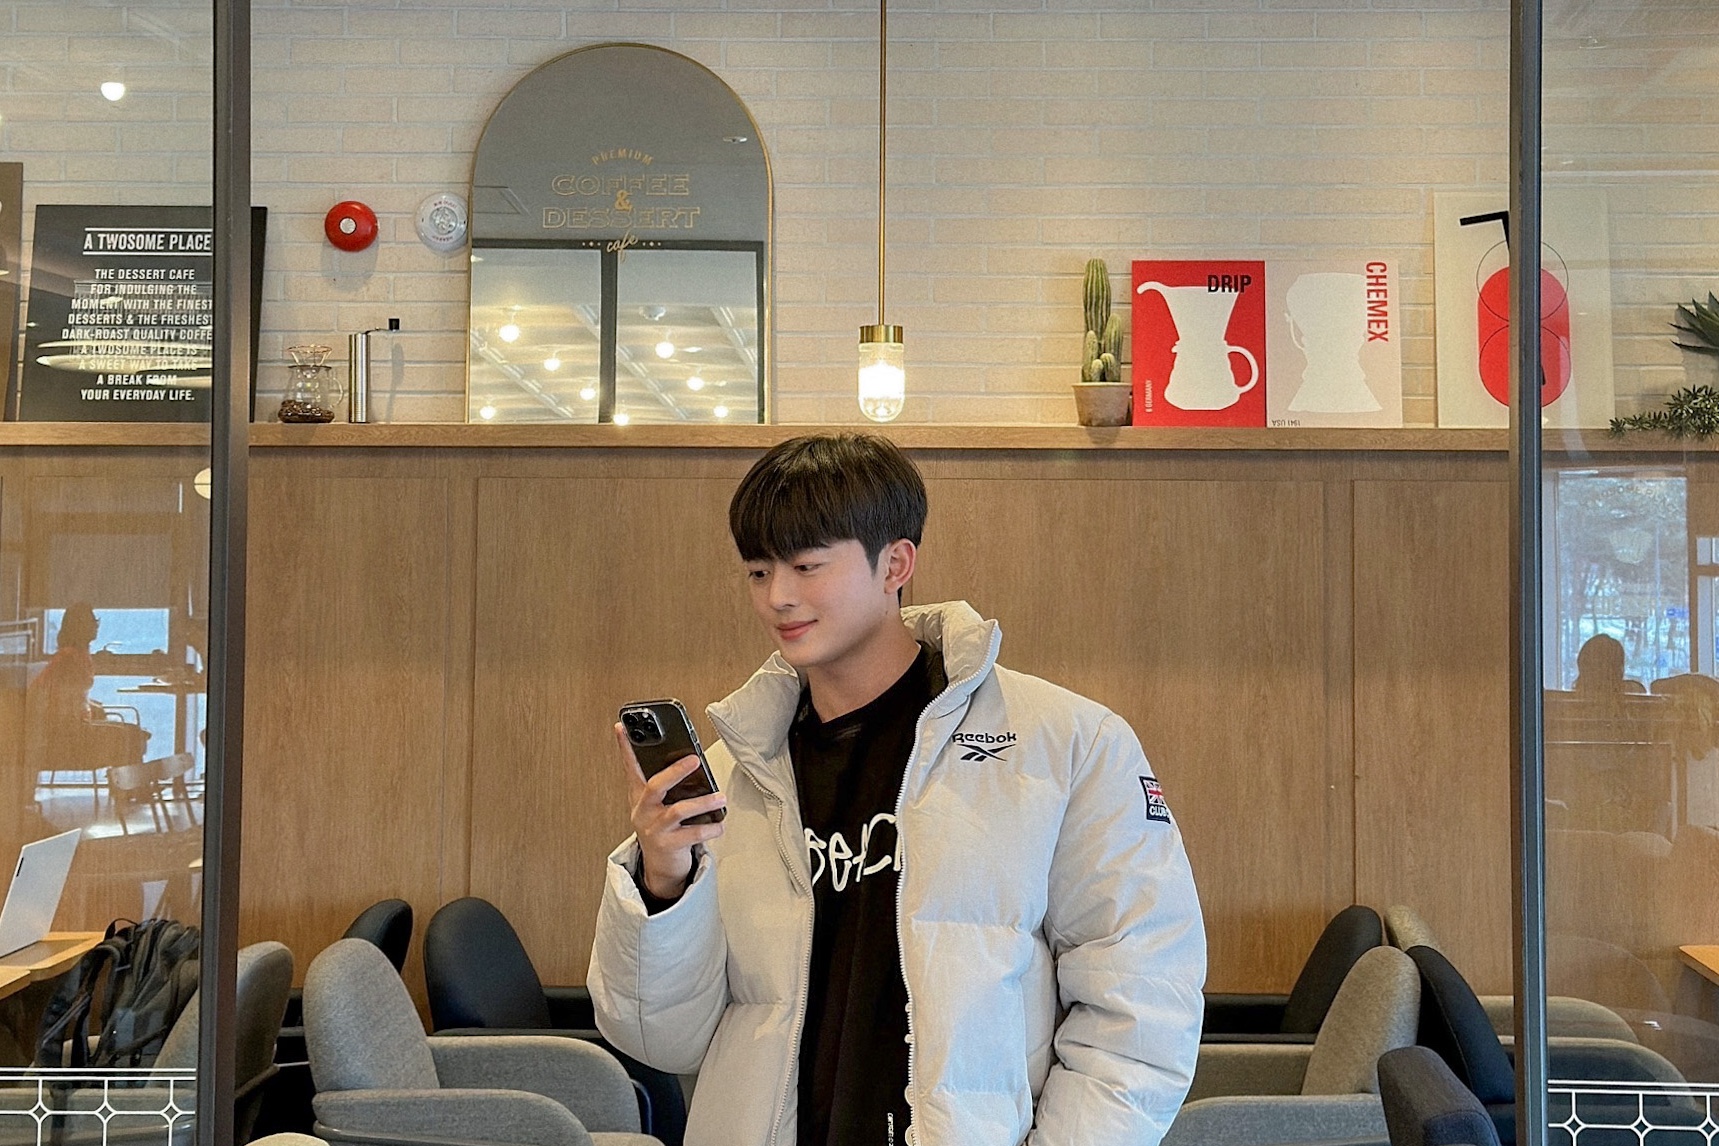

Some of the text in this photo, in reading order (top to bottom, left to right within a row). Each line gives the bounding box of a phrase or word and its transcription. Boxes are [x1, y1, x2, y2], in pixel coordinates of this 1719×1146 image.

[551, 173, 690, 196] COFFEE
[614, 189, 633, 211] &
[542, 206, 701, 229] DESSERT
[83, 233, 212, 250] A TWOSOME PLACE
[606, 230, 639, 263] cafe
[94, 268, 195, 280] THE DESSERT CAFE
[90, 283, 197, 295] FOR INDULGING THE
[1207, 274, 1252, 294] DRIP
[71, 298, 212, 310] MOMENT WITH THE FINEST
[1365, 261, 1389, 343] CHEMEX
[67, 313, 123, 325] DESSERTS
[126, 314, 134, 325] &
[138, 314, 158, 325] THE
[61, 328, 212, 341] DARK-ROAST QUALITY COFFE
[80, 344, 198, 355] A TWOSOME PLACE IS
[78, 359, 86, 370] A
[89, 359, 126, 370] SWEET
[130, 359, 152, 370] WAY
[96, 374, 178, 386] A BREAK FROM
[80, 389, 196, 401] YOUR EVERYDAY LIFE.
[951, 731, 1018, 744] Reebok
